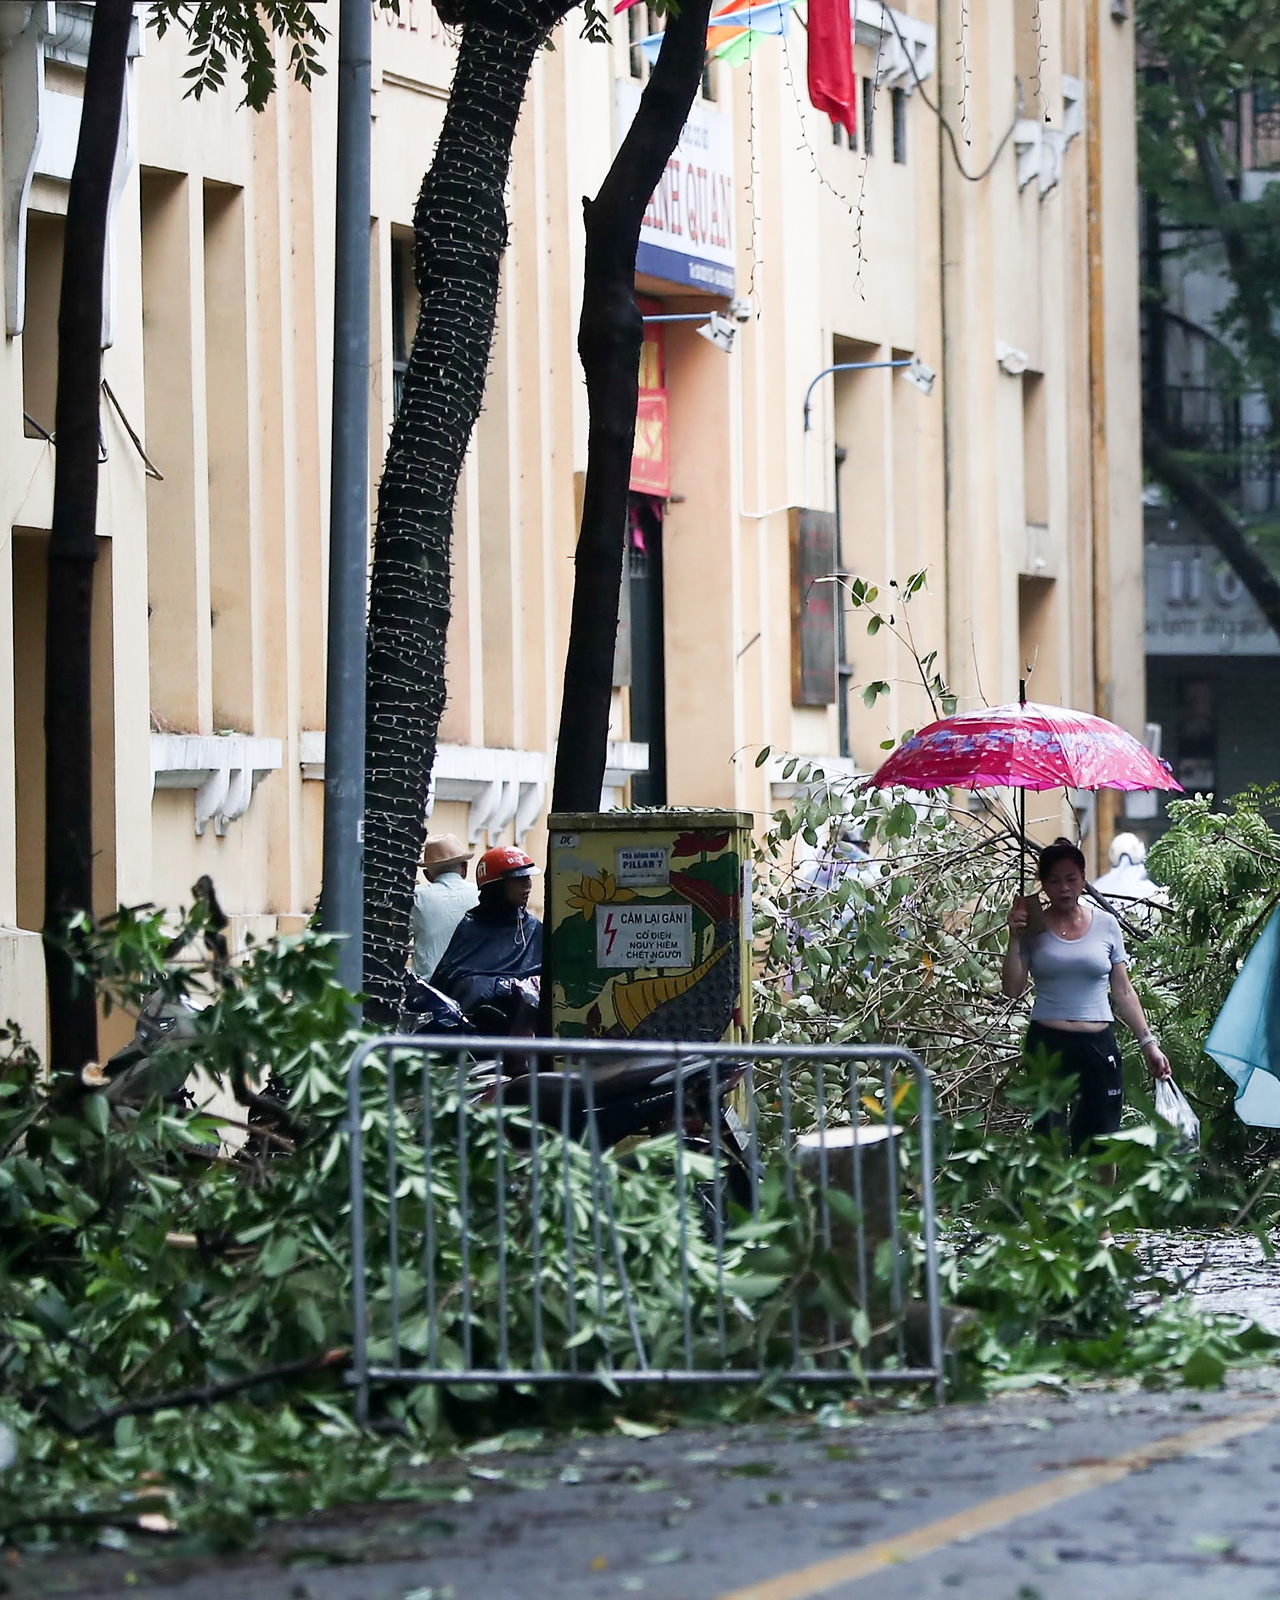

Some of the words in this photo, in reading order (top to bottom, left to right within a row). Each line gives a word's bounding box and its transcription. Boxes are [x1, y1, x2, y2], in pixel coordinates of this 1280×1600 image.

[622, 860, 655, 869] PILLAR
[657, 860, 663, 868] 7
[644, 913, 660, 926] LẠI
[651, 930, 672, 941] ĐIỆN
[629, 941, 655, 949] NGUY
[651, 949, 682, 959] NGƯỜI
